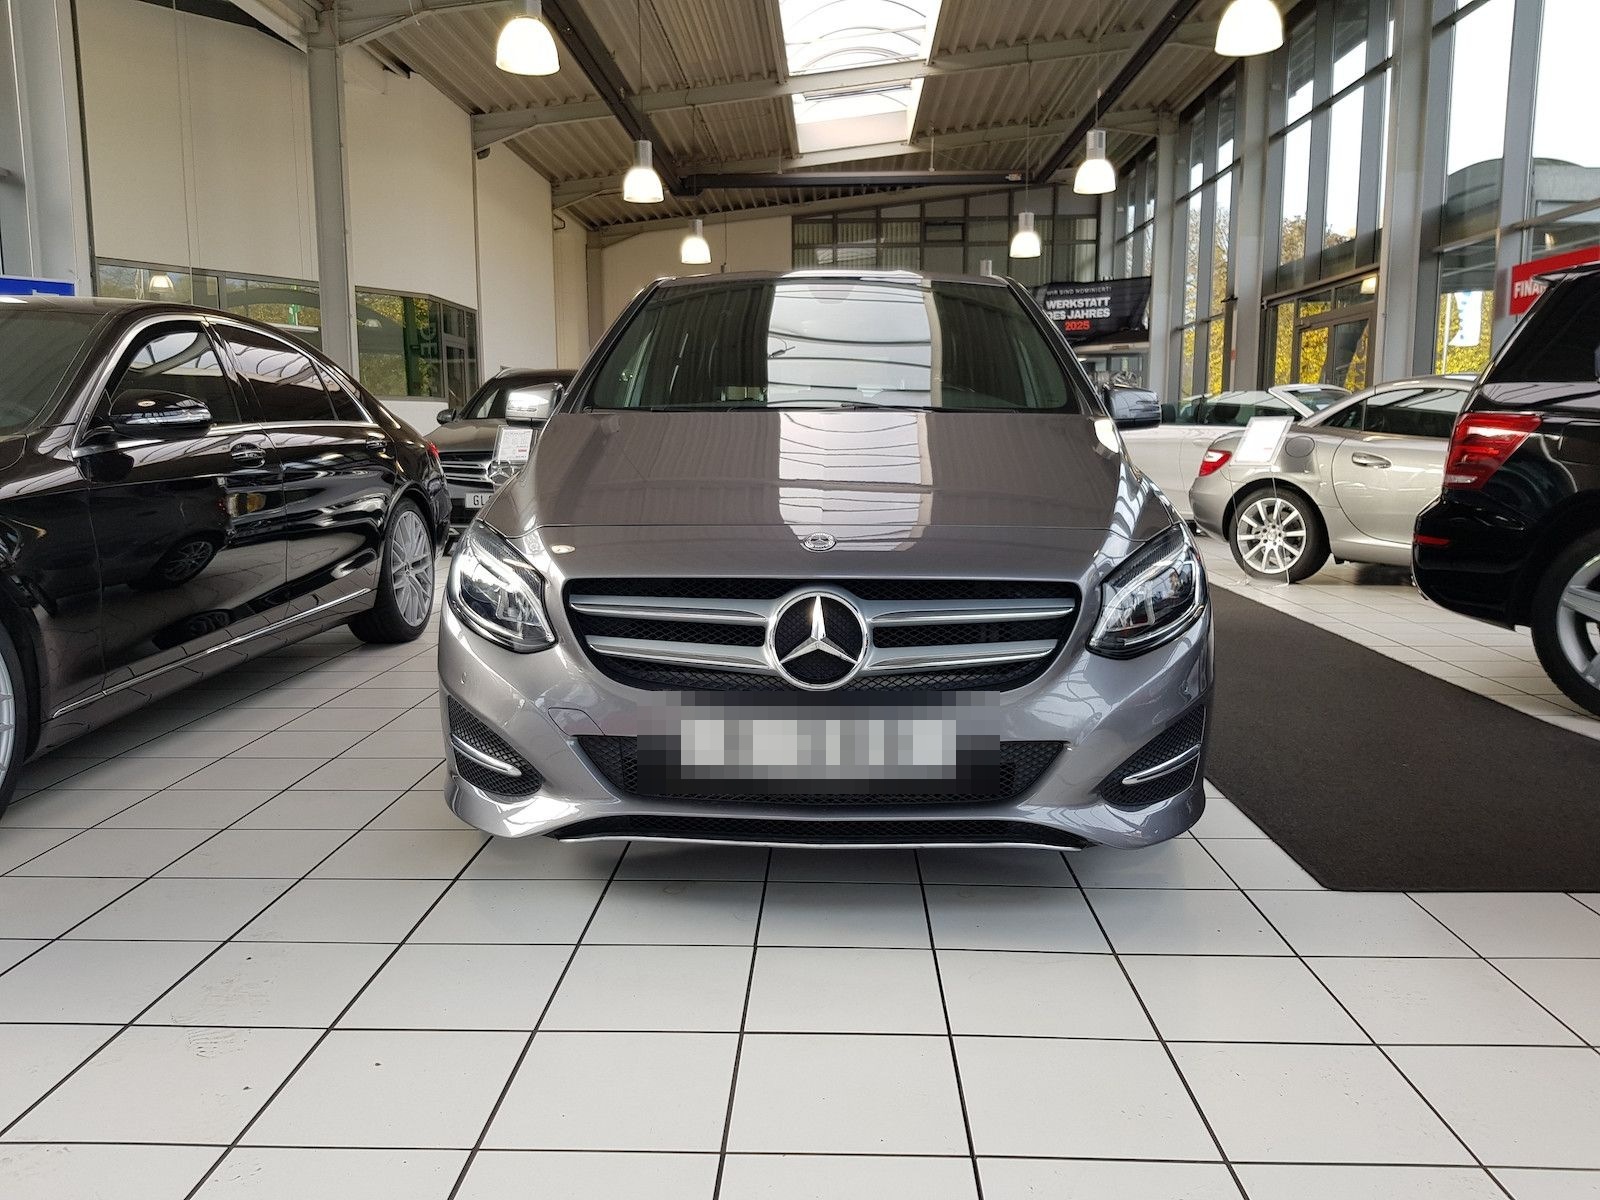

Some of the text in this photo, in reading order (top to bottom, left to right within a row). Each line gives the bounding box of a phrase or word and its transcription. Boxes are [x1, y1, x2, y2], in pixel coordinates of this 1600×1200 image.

[1046, 297, 1111, 310] WERKSTATT
[1067, 307, 1111, 319] JAHRES
[1064, 320, 1090, 331] 2025
[473, 494, 491, 506] GL
